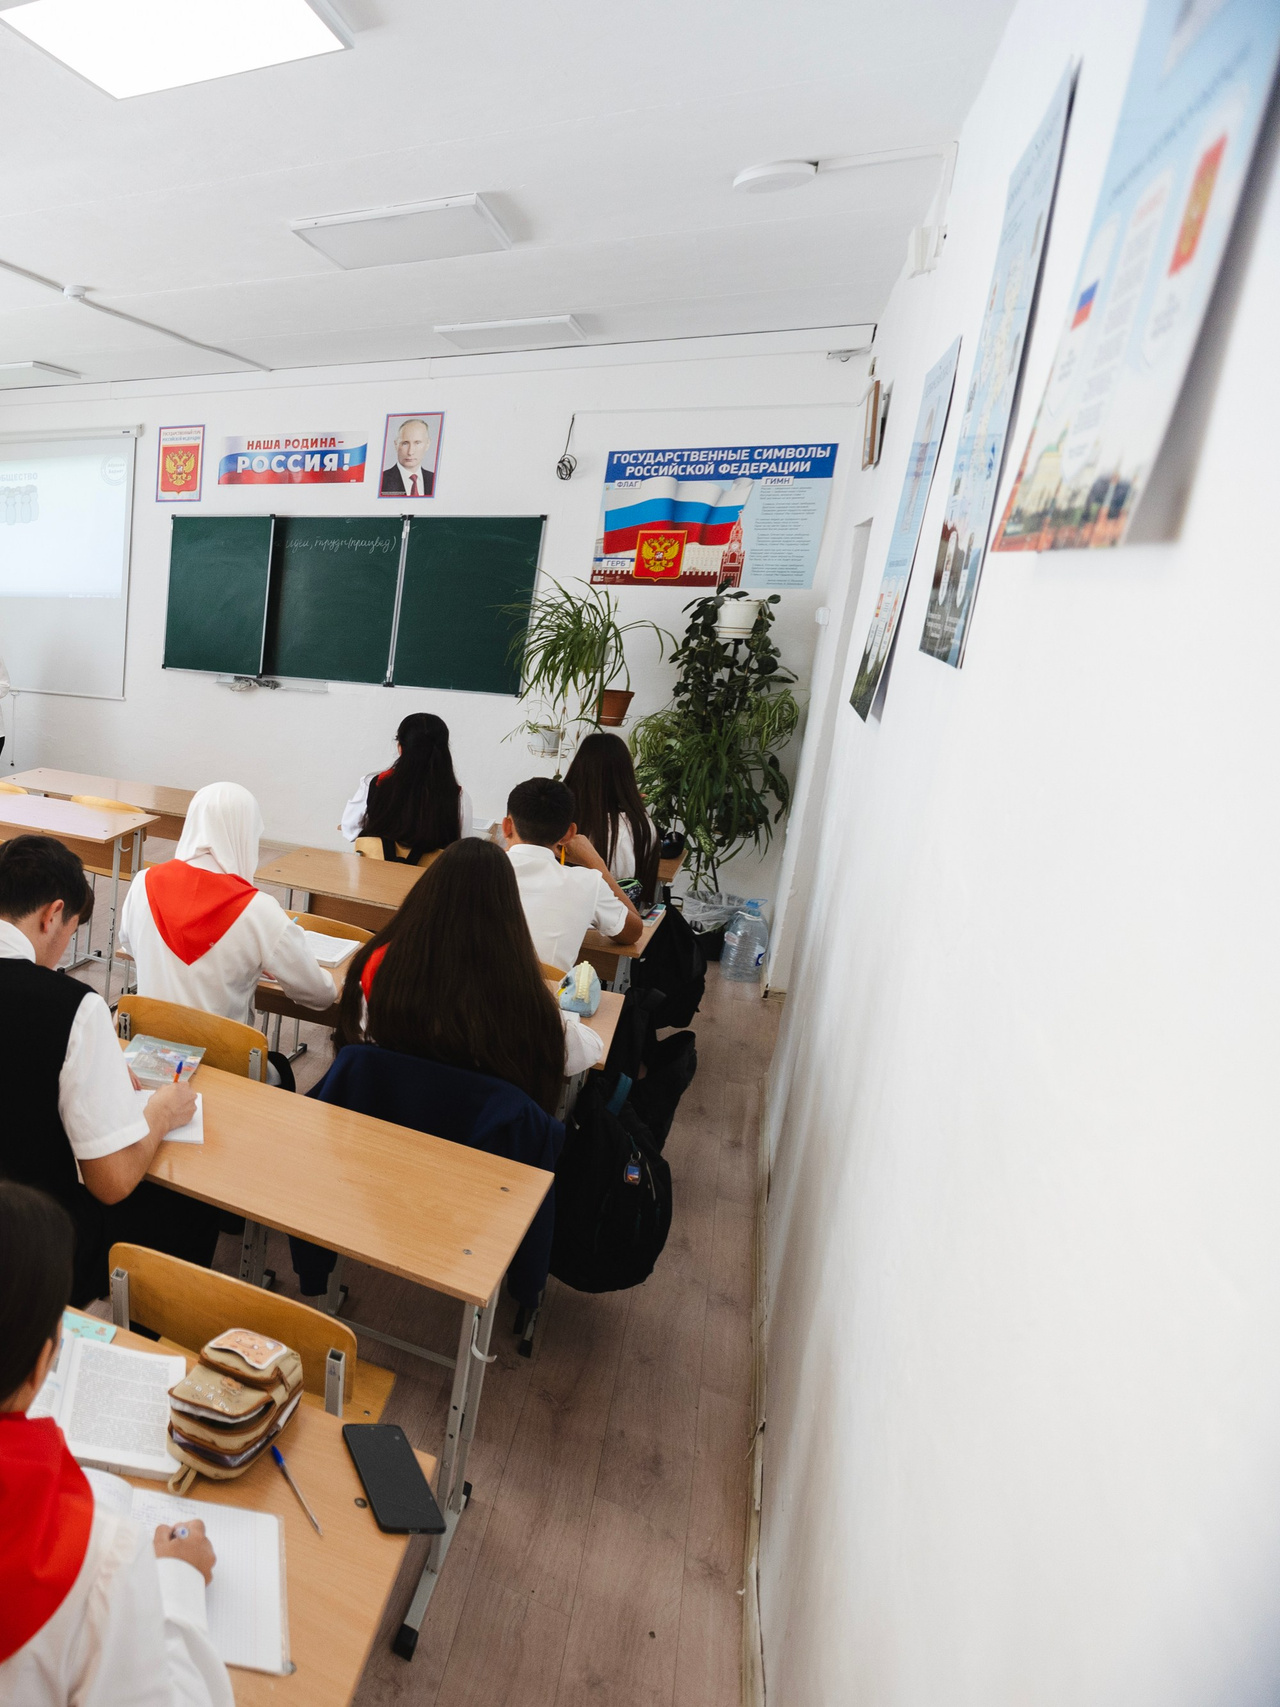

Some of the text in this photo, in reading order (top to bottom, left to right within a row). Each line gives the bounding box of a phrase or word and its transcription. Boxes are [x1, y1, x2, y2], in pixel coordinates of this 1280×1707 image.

[247, 438, 282, 450] НАША
[613, 446, 831, 464] ГОСУДАРСТВЕННЫЕ СИМВОЛЫ
[236, 452, 351, 474] РОССИЯ!
[625, 461, 812, 477] РОССИЙСКОЙ ФЕДЕРАЦИИ
[616, 480, 640, 488] ФЛАГ
[764, 477, 791, 486] ГИМН
